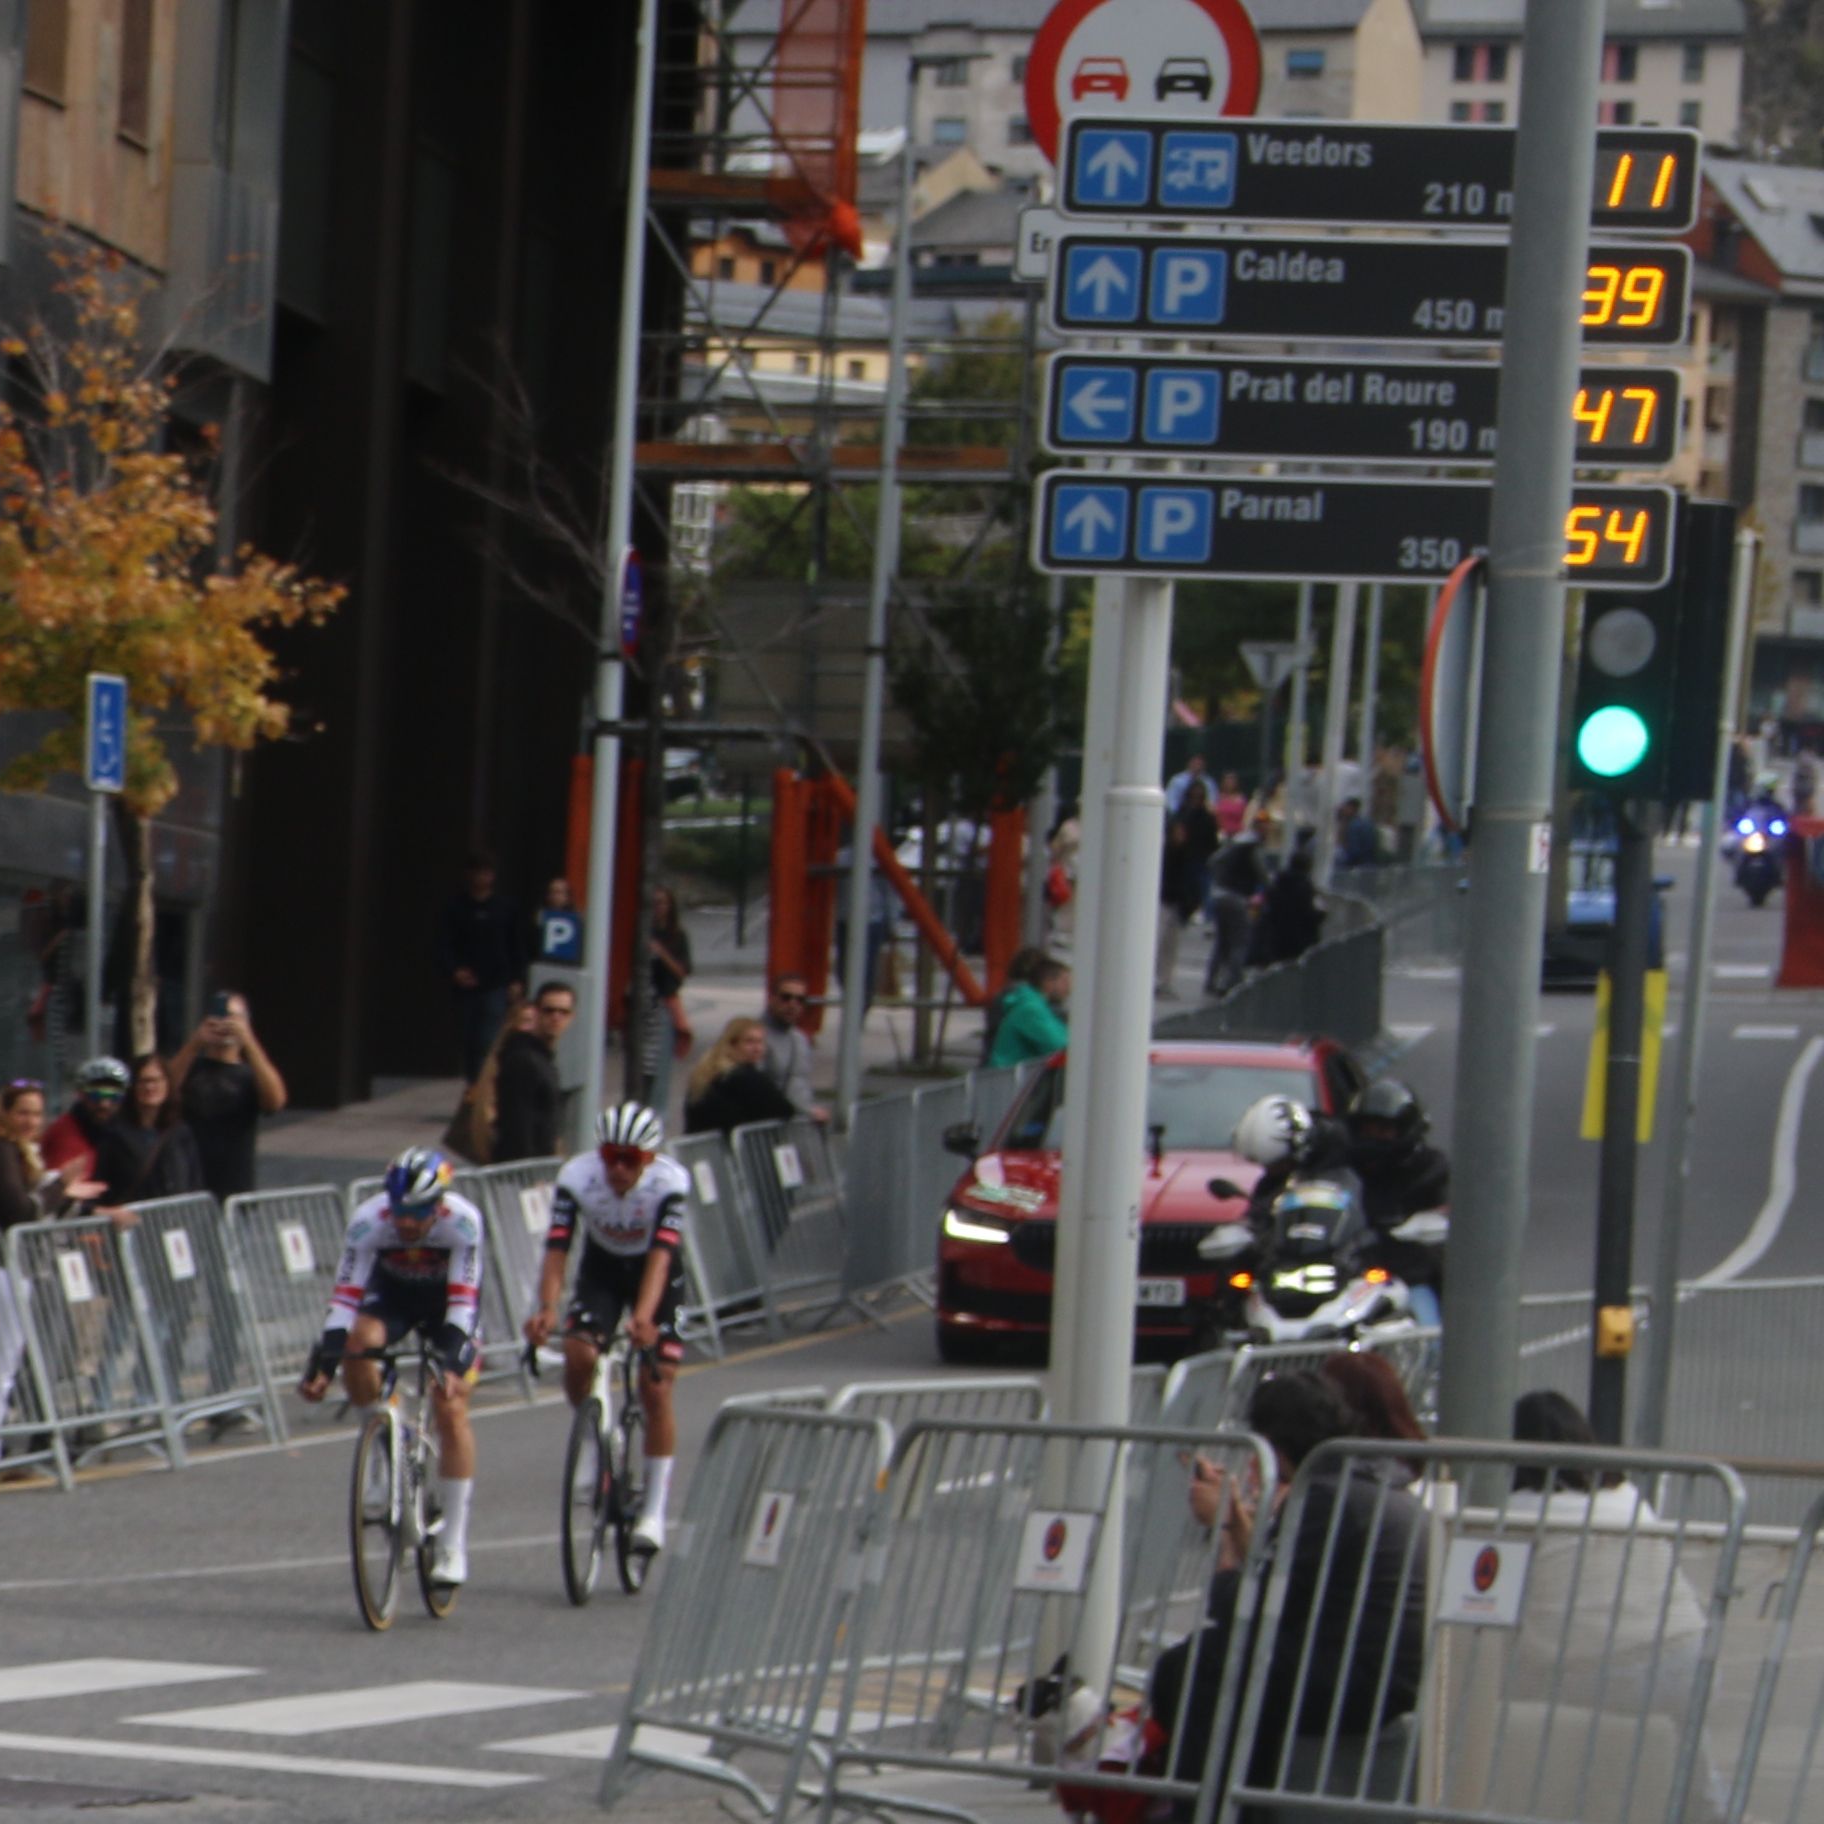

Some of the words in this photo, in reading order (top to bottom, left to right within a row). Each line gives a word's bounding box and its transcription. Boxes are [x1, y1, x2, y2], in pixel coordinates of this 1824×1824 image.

[1247, 133, 1373, 168] Veedors
[1423, 182, 1486, 215] 210
[1607, 153, 1677, 208] 11
[1235, 247, 1346, 284] Caldea
[1580, 265, 1665, 327] 39
[1413, 298, 1475, 331] 450
[1228, 370, 1295, 402] Prat
[1304, 372, 1352, 404] del
[1363, 374, 1456, 407] Roure
[1572, 387, 1658, 444] 47
[1409, 418, 1469, 451] 190
[1220, 488, 1324, 522] Parnal
[1398, 537, 1460, 569] 350
[1562, 506, 1649, 565] 54
